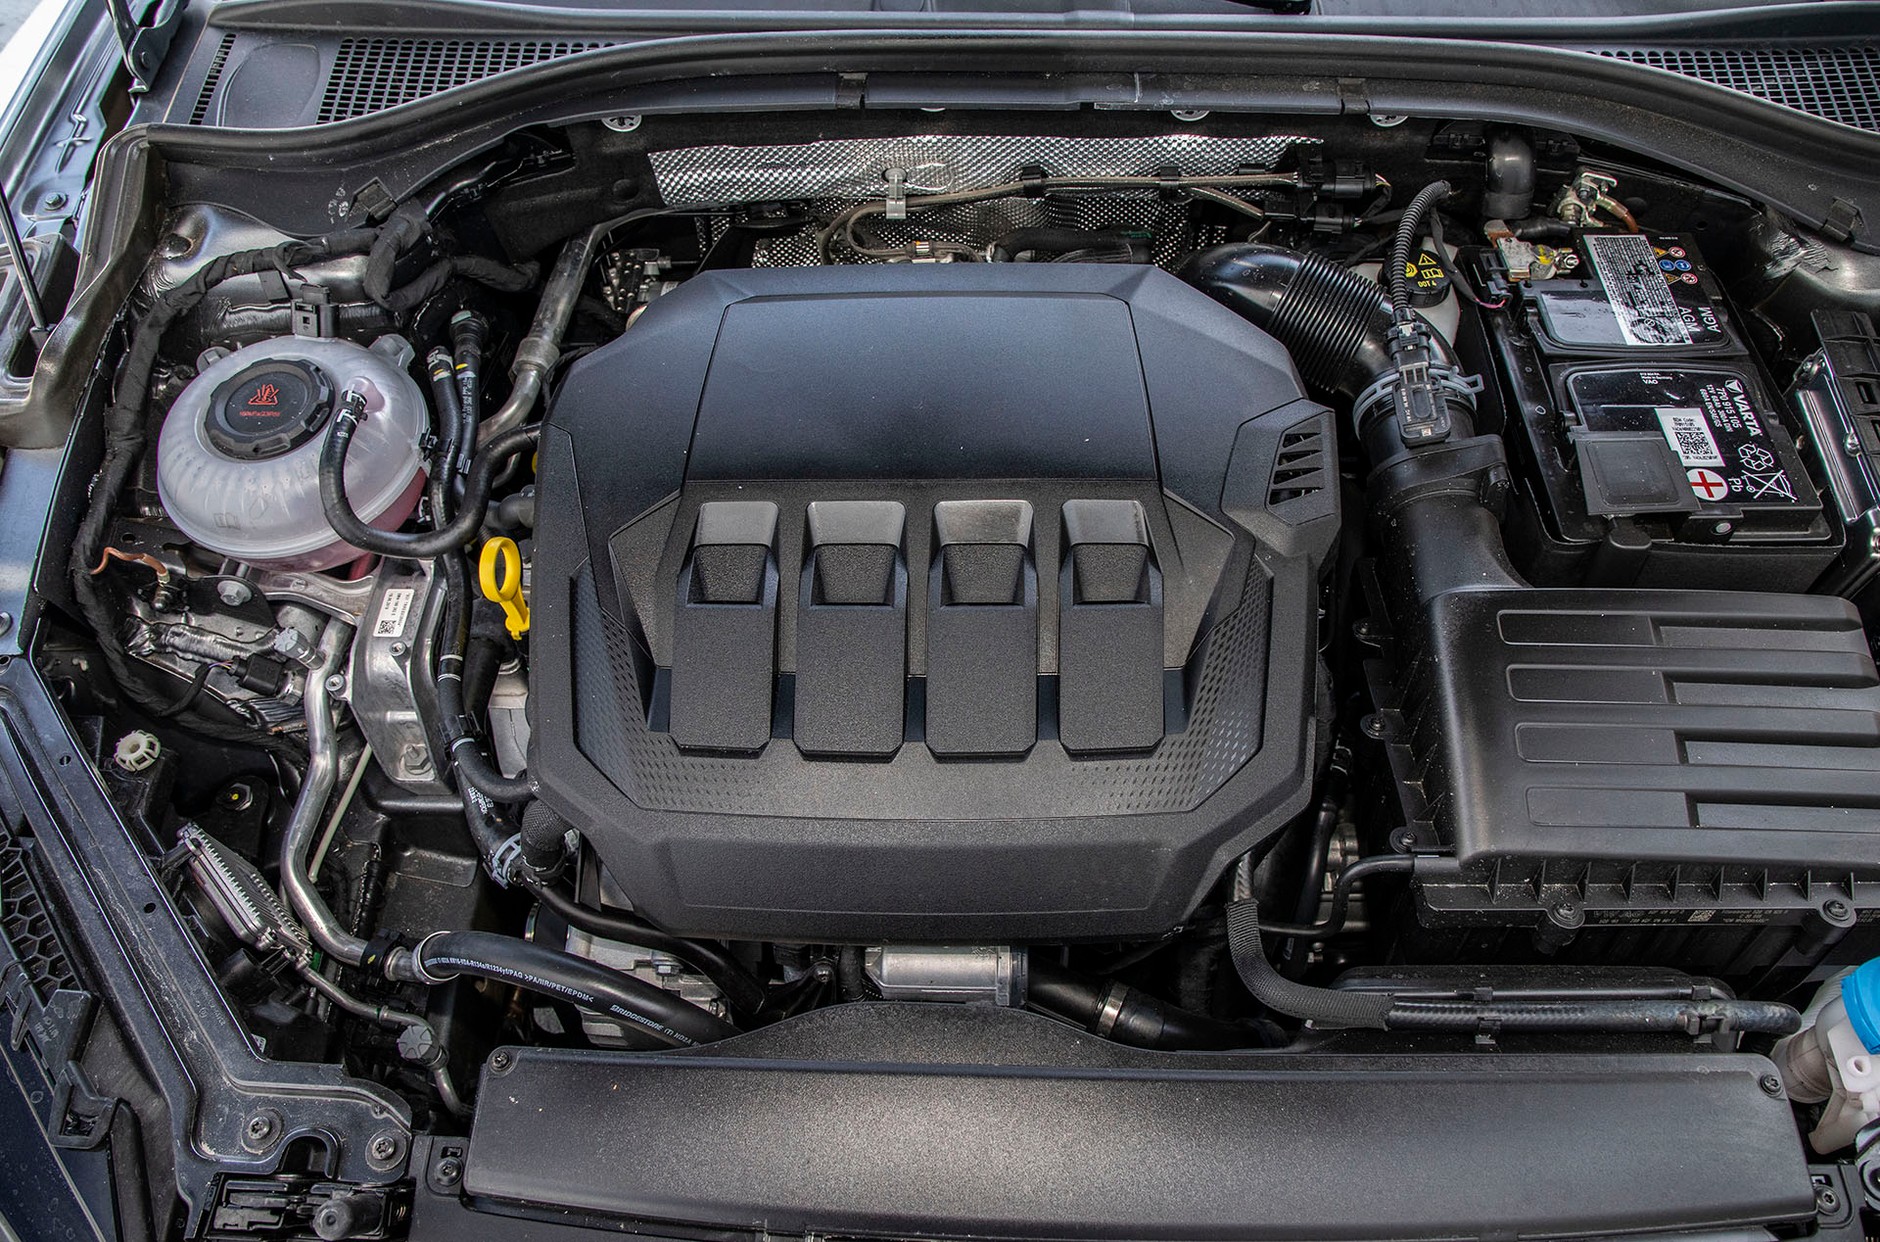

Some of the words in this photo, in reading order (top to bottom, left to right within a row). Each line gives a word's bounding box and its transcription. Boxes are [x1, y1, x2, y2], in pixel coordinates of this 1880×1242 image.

[1679, 306, 1700, 332] AGM
[1698, 306, 1721, 333] AGM
[1722, 401, 1736, 415] 915
[1729, 415, 1743, 429] 105
[1733, 394, 1762, 437] VARTA
[1728, 477, 1743, 492] Pb
[610, 1004, 664, 1032] BRIDGESTONE
